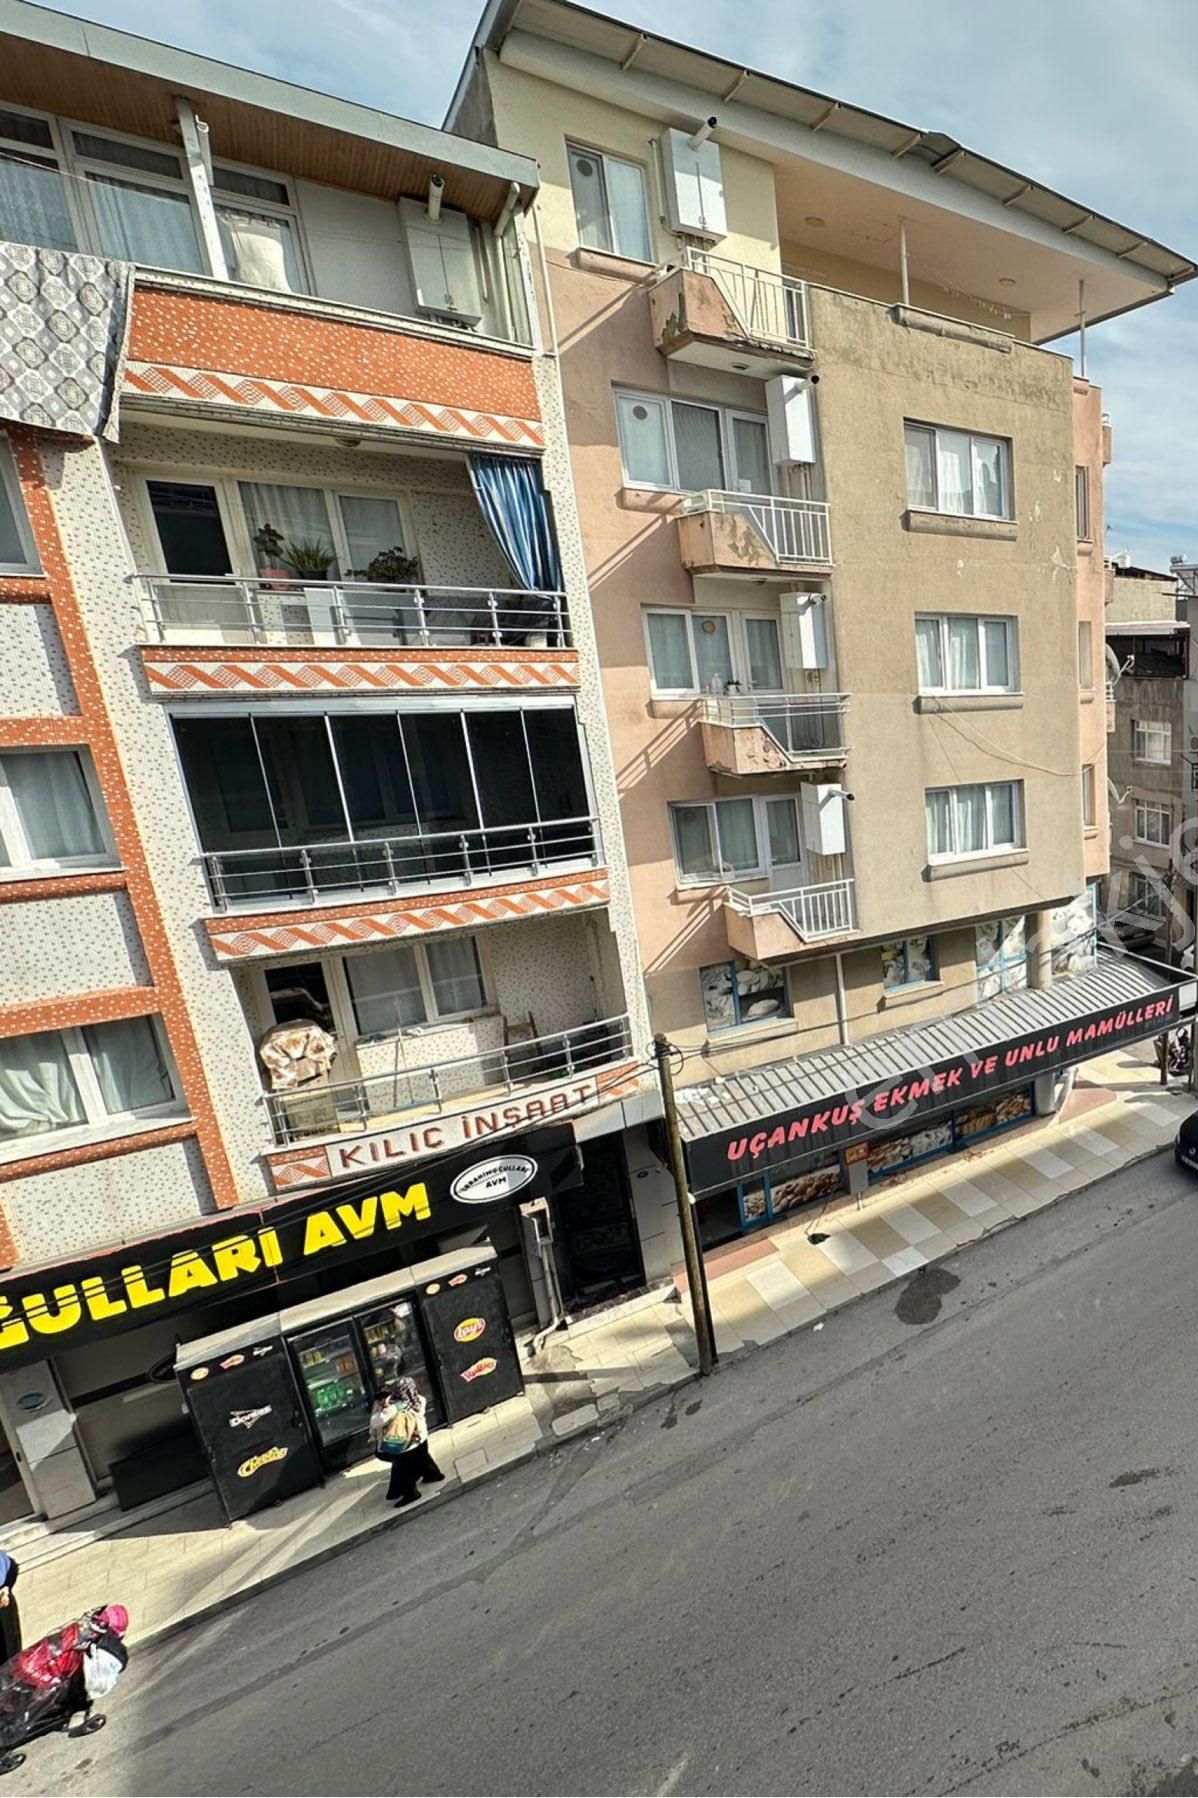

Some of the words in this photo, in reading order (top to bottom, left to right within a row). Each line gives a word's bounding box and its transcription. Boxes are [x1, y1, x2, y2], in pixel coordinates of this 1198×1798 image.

[727, 1100, 864, 1161] UÇANKUŞ
[873, 1066, 962, 1112] EKMEK
[970, 1053, 998, 1081] VE
[1005, 1035, 1060, 1068] UNLU
[1066, 996, 1175, 1047] MAMÜLLERİ
[303, 1182, 431, 1256] AVM
[485, 1176, 507, 1189] AVM
